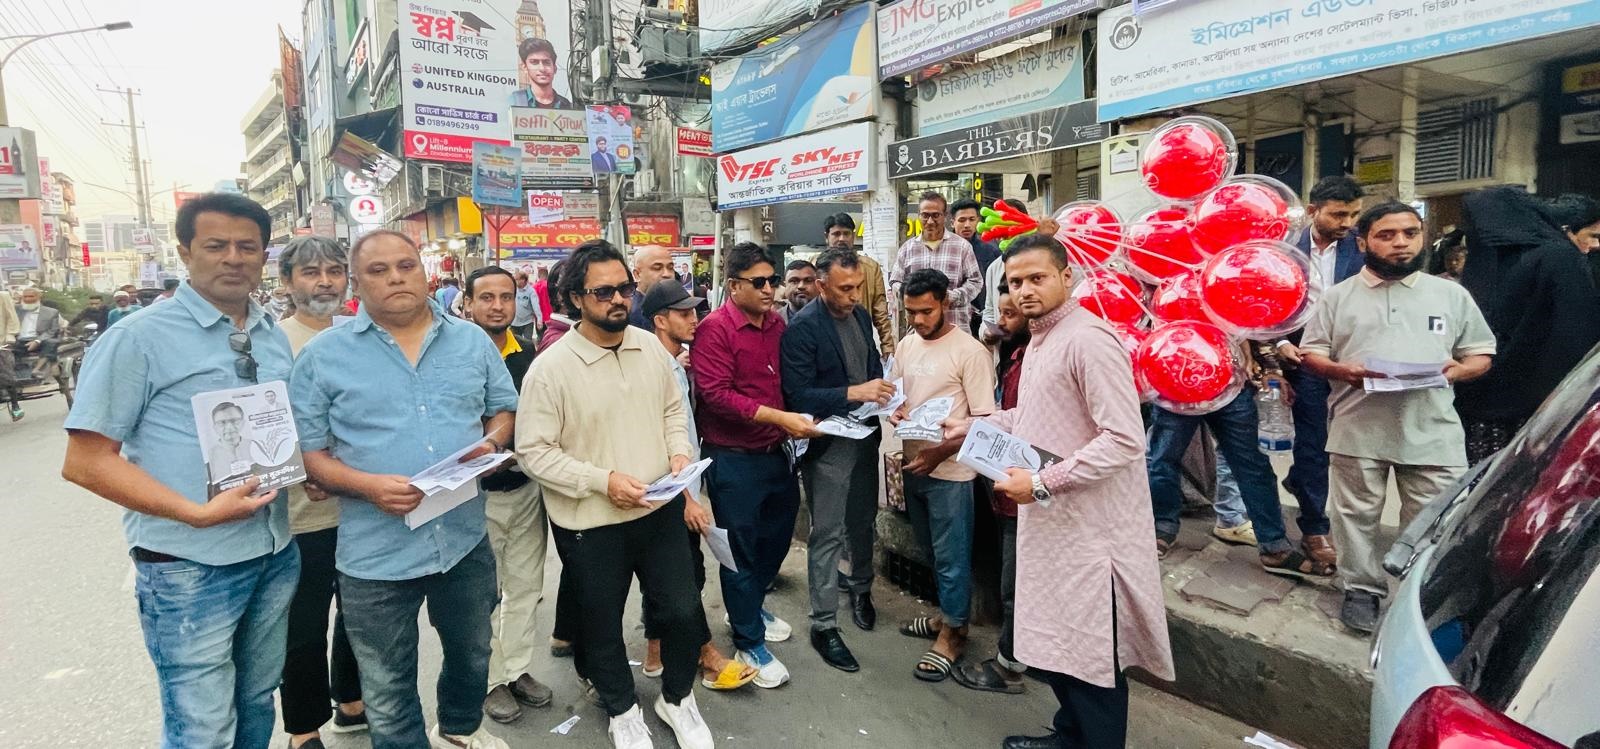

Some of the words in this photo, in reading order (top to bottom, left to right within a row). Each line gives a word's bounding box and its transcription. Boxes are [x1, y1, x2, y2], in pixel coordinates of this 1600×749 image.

[409, 11, 456, 42] স্বপ্ন
[890, 0, 936, 37] JMG
[937, 0, 997, 23] Expre
[1191, 8, 1293, 46] ইমিগ্রেশন
[410, 37, 450, 55] আরো
[452, 44, 489, 61] সহজে
[456, 34, 474, 45] পূরণ
[475, 38, 489, 48] হবে
[1135, 65, 1169, 80] আমেরিকা,
[1172, 57, 1201, 71] কানাডা,
[1243, 45, 1256, 54] সহ
[1293, 28, 1323, 43] দেশের
[424, 65, 465, 79] UNITED
[467, 71, 517, 87] KINGDOM
[426, 81, 486, 97] AUSTRALIA
[426, 118, 481, 131] 01894962949
[515, 114, 548, 129] ISHTI
[966, 125, 994, 141] THE
[921, 125, 1054, 168] BARBERS
[738, 157, 782, 182] TSC
[779, 164, 787, 175] &
[728, 186, 774, 200] আন্তর্জাতিক
[777, 179, 813, 195] কুরিয়ার
[817, 172, 852, 185] সার্ভিস
[532, 196, 562, 207] OPEN
[500, 233, 548, 247] ভাড়া
